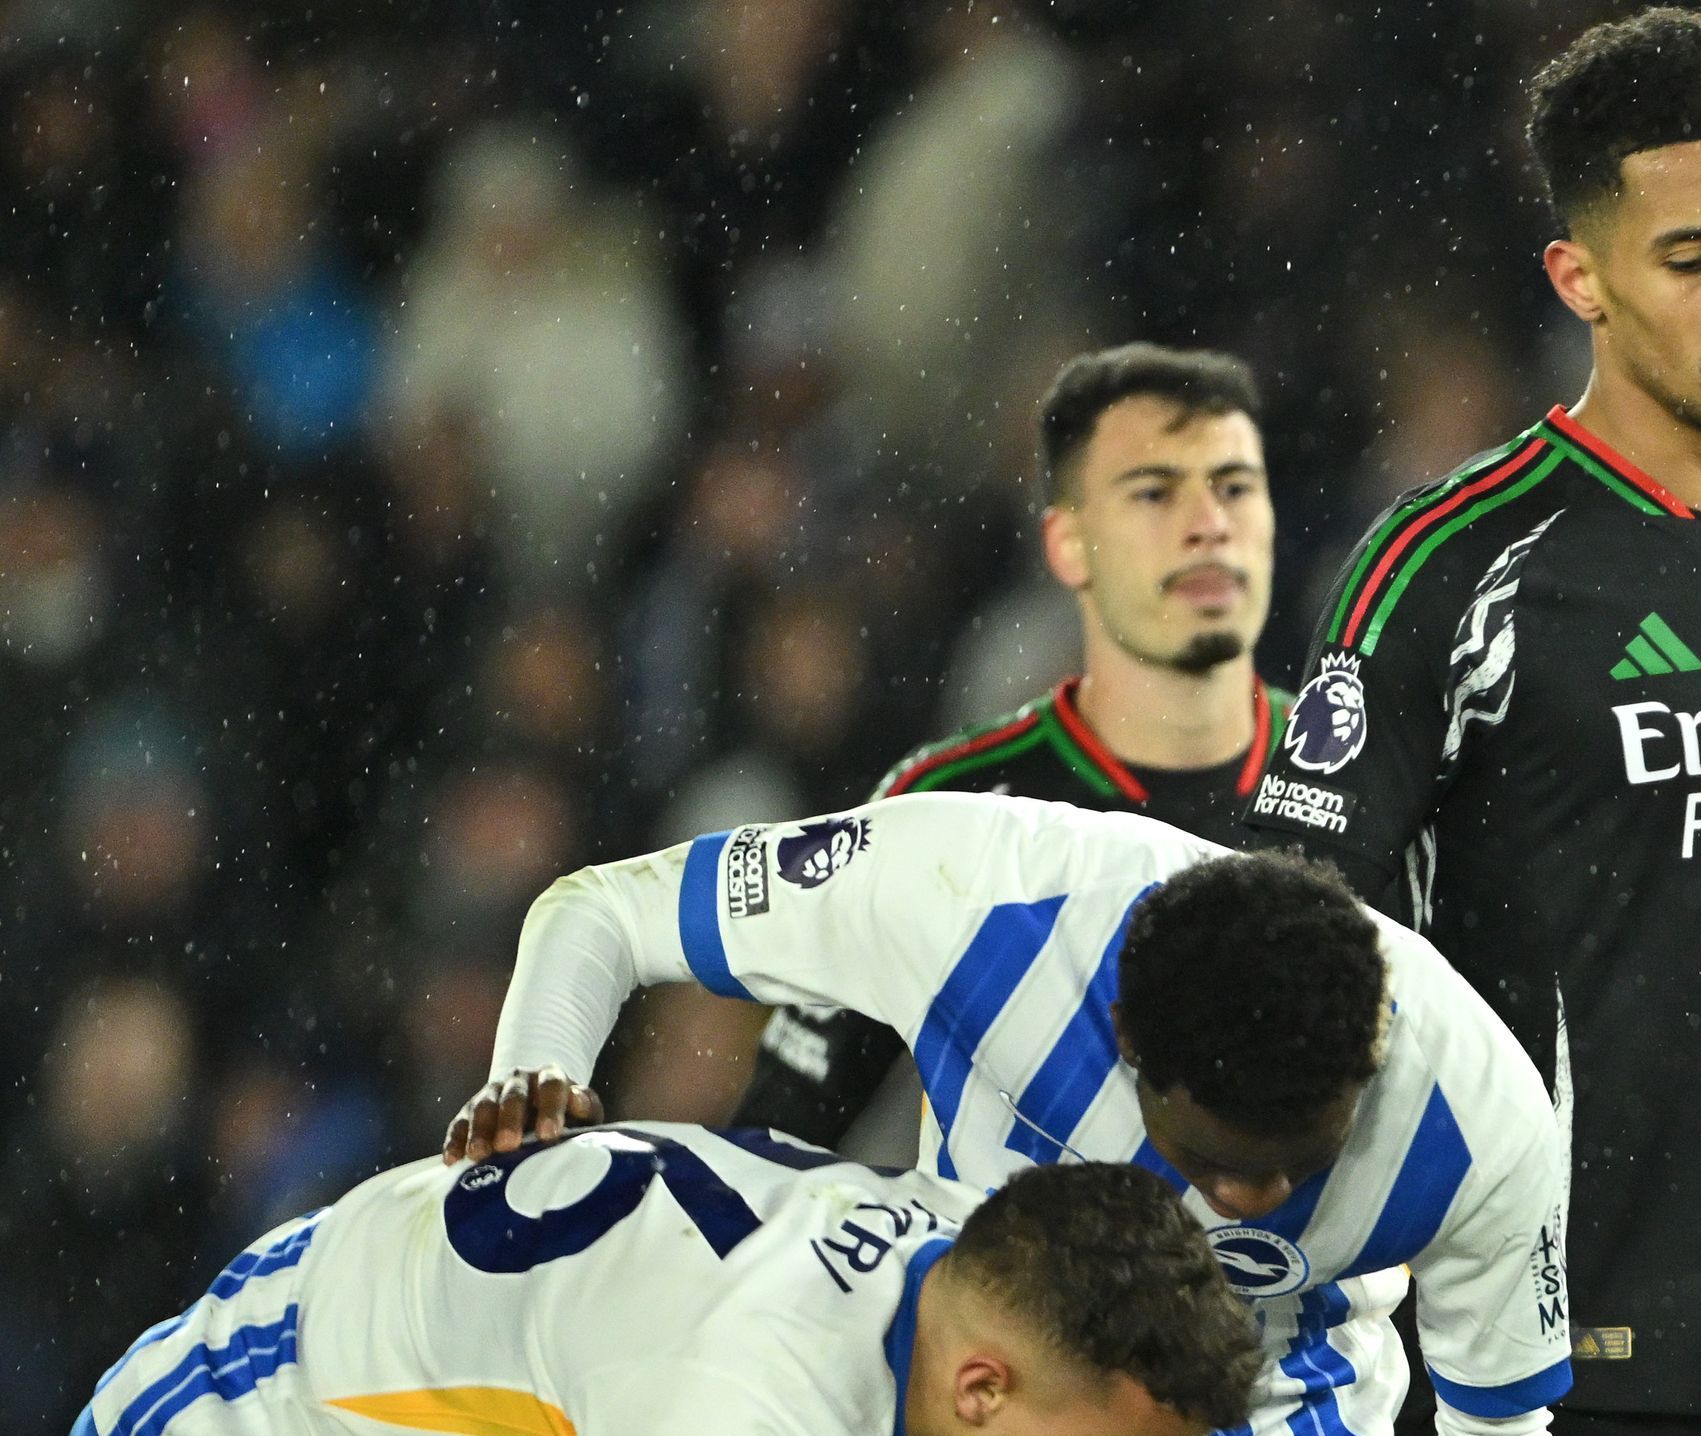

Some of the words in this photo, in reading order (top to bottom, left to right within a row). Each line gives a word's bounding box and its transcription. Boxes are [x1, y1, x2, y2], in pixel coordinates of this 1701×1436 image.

[1260, 774, 1286, 797] No
[1285, 782, 1344, 812] room
[1254, 793, 1280, 814] for
[1277, 799, 1348, 833] racism
